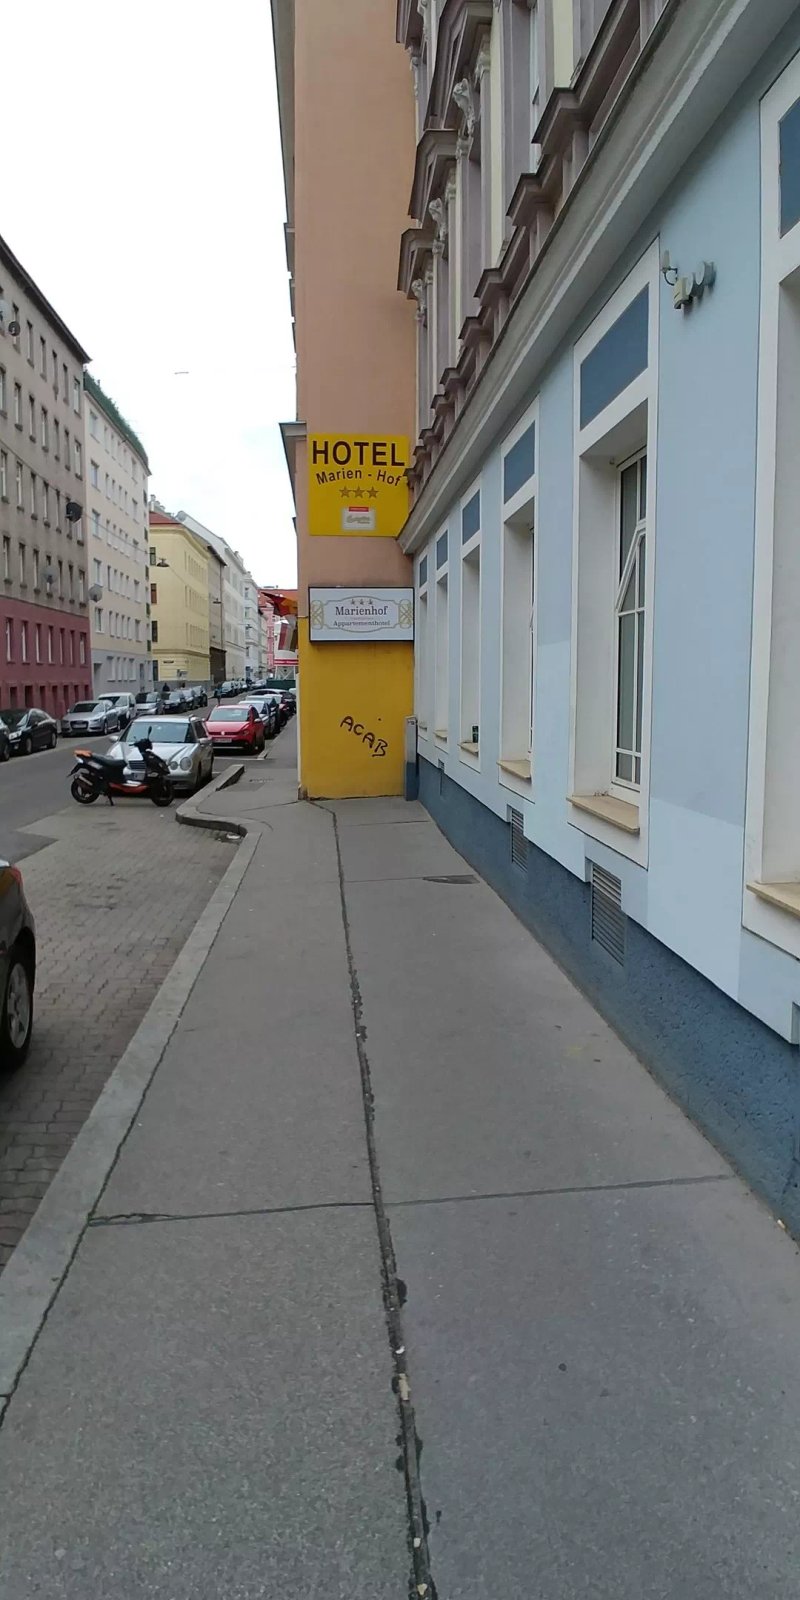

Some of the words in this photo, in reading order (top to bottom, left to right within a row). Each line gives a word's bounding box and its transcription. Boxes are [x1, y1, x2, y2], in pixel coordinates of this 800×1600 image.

[312, 440, 405, 467] HOTEL
[316, 468, 362, 485] Marien
[376, 469, 402, 486] Hof
[335, 605, 389, 616] Marienhof
[339, 715, 388, 757] ACAB
